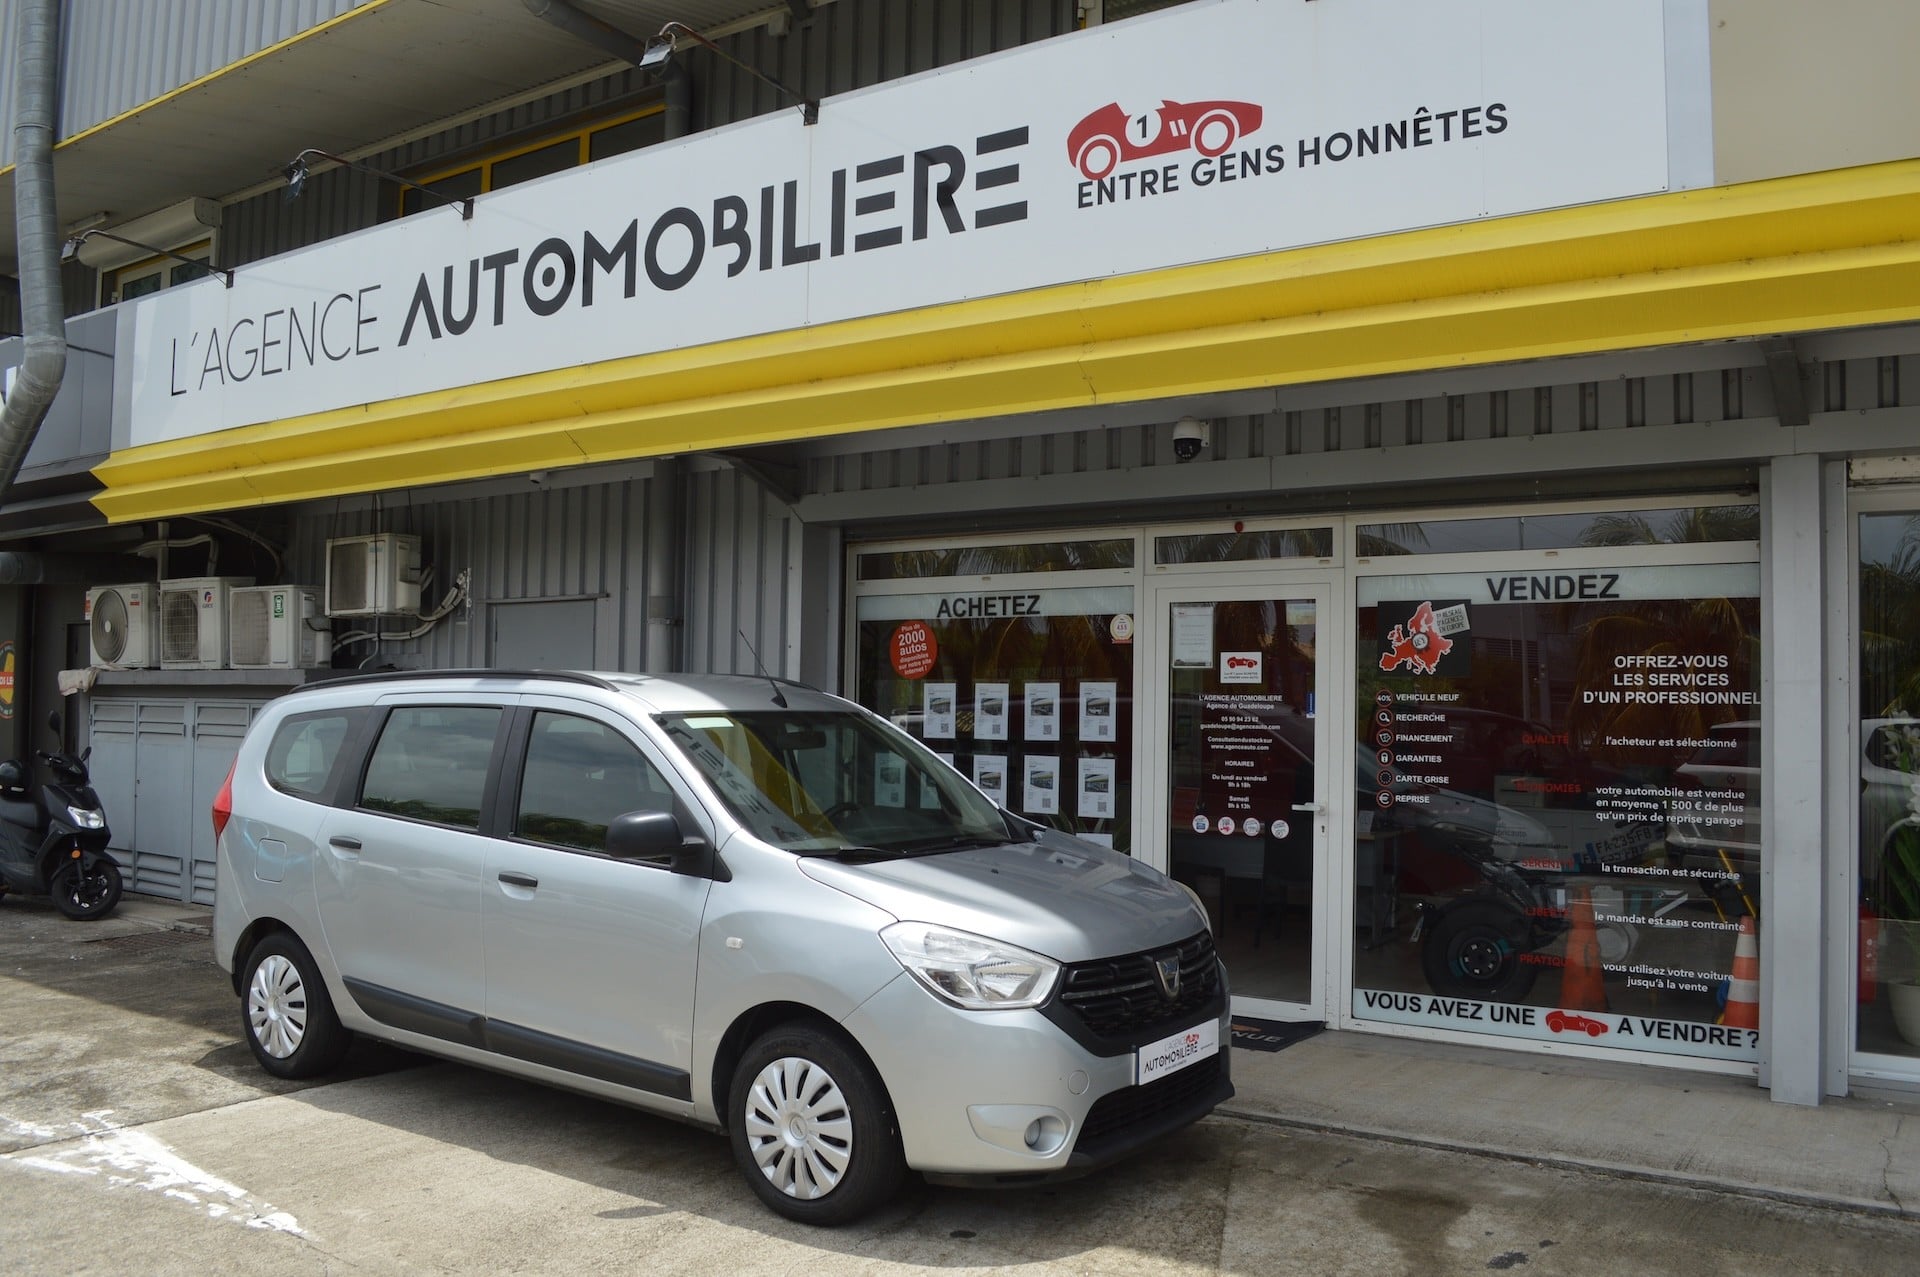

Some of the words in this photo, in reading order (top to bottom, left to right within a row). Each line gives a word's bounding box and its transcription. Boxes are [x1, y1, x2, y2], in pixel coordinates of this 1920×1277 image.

[1077, 162, 1179, 209] ENTRE
[1191, 145, 1285, 189] GENS
[1297, 102, 1508, 168] HONNÊTES
[170, 284, 382, 397] L'AGENCE
[397, 125, 1029, 347] AUTOMOBILIERE
[1486, 574, 1620, 601] VENDEZ
[936, 594, 1041, 619] ACHETEZ
[898, 629, 926, 647] 2000
[899, 642, 928, 656] autos
[1613, 654, 1729, 670] OFFREZ-VOUS
[1613, 671, 1644, 687] LES
[1647, 671, 1730, 687] SERVICES
[1437, 694, 1460, 702] NEUF
[1583, 690, 1621, 705] D'UN
[1624, 690, 1761, 706] PROFESSIONNEL
[1206, 703, 1229, 711] Agence
[1238, 703, 1275, 711] Guadeloupe
[1396, 713, 1446, 722] RECHERCHE
[1396, 734, 1454, 743] FINANCEMENT
[1605, 735, 1655, 747] l'acheteur
[1658, 737, 1674, 747] est
[1676, 736, 1738, 750] sélectionné
[1396, 755, 1442, 763] GARANTIES
[1396, 775, 1423, 783] CARTE
[1424, 776, 1449, 784] GRISE
[1395, 795, 1430, 803] REPRISE
[1596, 786, 1623, 796] votre
[1625, 786, 1684, 797] automobile
[1686, 788, 1703, 799] est
[1705, 788, 1745, 800] vendue
[1596, 799, 1608, 808] en
[1610, 800, 1660, 813] moyenne
[1670, 800, 1692, 811] 500
[1694, 801, 1702, 811] €
[1704, 801, 1717, 812] de
[1719, 802, 1744, 815] plus
[1596, 810, 1625, 823] qu'un
[1627, 811, 1647, 824] prix
[1649, 812, 1663, 822] de
[1665, 812, 1703, 826] reprise
[1705, 815, 1743, 828] garage
[1602, 863, 1611, 873] la
[1613, 864, 1670, 876] transaction
[1672, 867, 1687, 877] est
[1689, 868, 1740, 880] sécurisée
[1595, 912, 1604, 922] le
[1607, 913, 1645, 925] mandat
[1648, 916, 1664, 926] est
[1666, 918, 1689, 927] sans
[1691, 918, 1745, 932] contrainte
[1603, 964, 1627, 974] vous
[1629, 964, 1666, 976] utilisez
[1667, 967, 1694, 978] votre
[1697, 969, 1734, 981] voiture
[1627, 977, 1664, 991] jusqu'à
[1666, 980, 1676, 990] la
[1678, 981, 1708, 992] vente
[1364, 990, 1421, 1013] VOUS
[1427, 998, 1483, 1019] AVEZ
[1489, 1005, 1536, 1026] UNE
[1617, 1016, 1635, 1035] A
[1640, 1018, 1743, 1047] VENDRE
[1144, 1041, 1199, 1074] AUTOMOBILIERE
